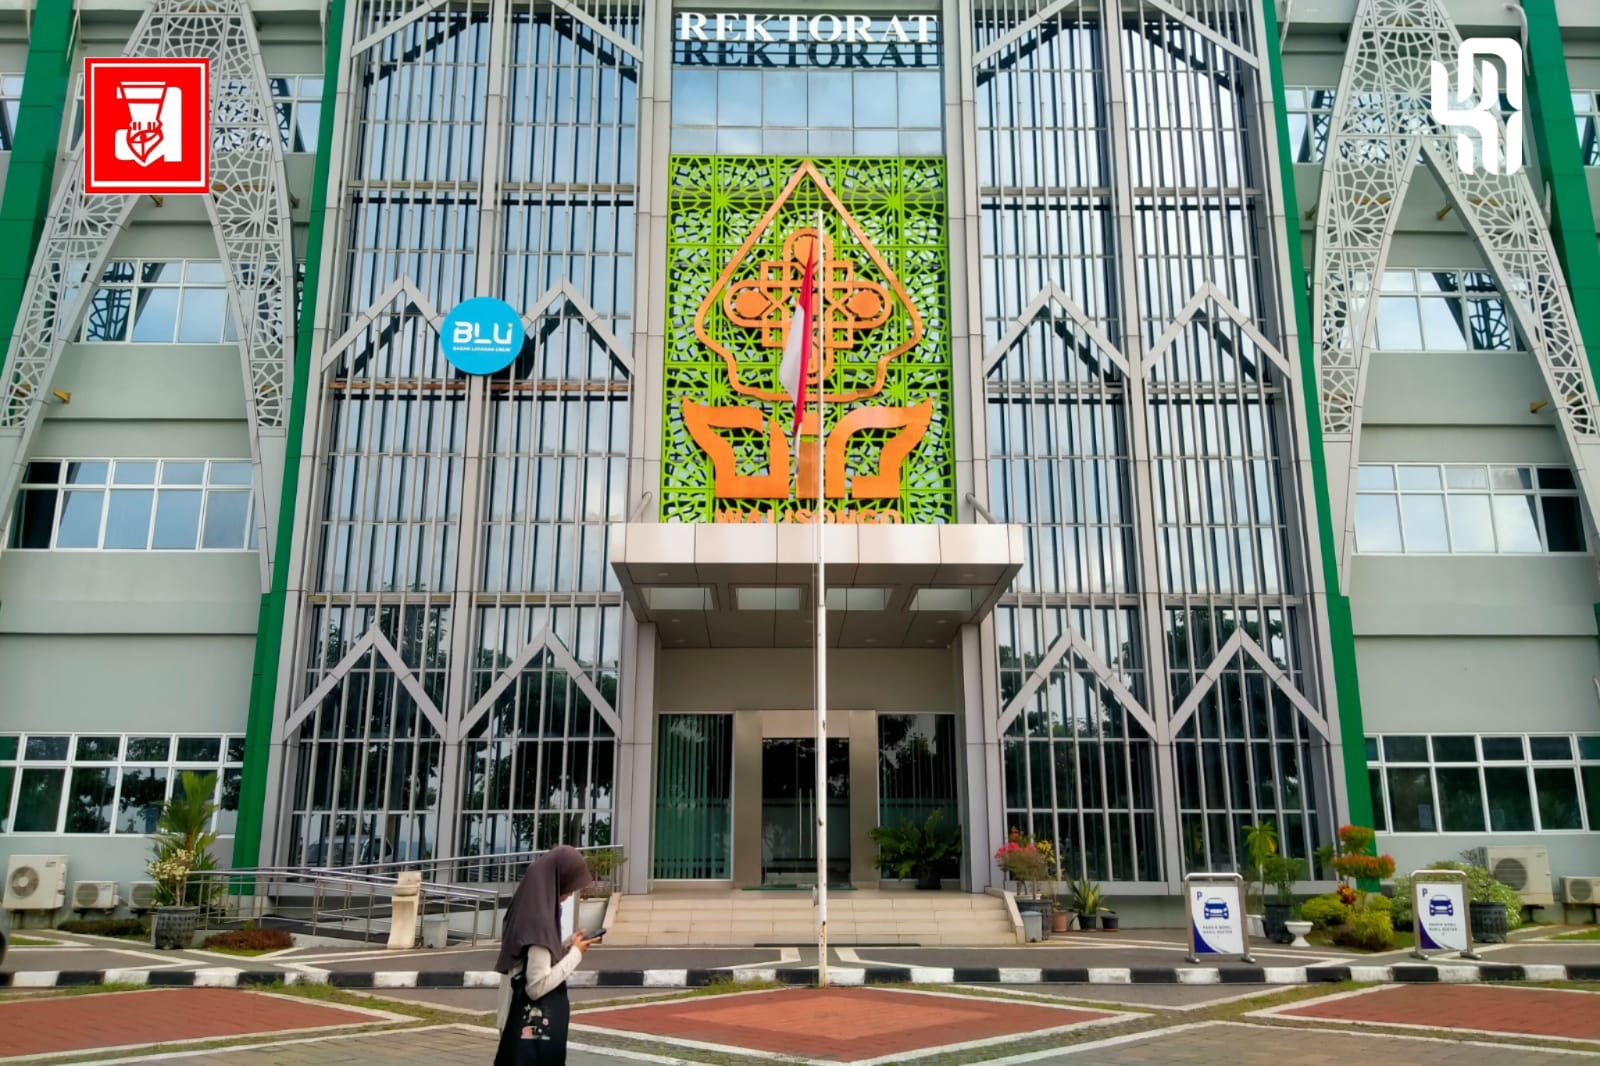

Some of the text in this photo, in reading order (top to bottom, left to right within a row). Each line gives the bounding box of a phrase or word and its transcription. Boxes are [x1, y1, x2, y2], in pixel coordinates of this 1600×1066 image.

[678, 12, 936, 42] REKTORAT
[453, 321, 513, 345] BLU
[1196, 891, 1203, 901] P
[1422, 887, 1429, 897] P
